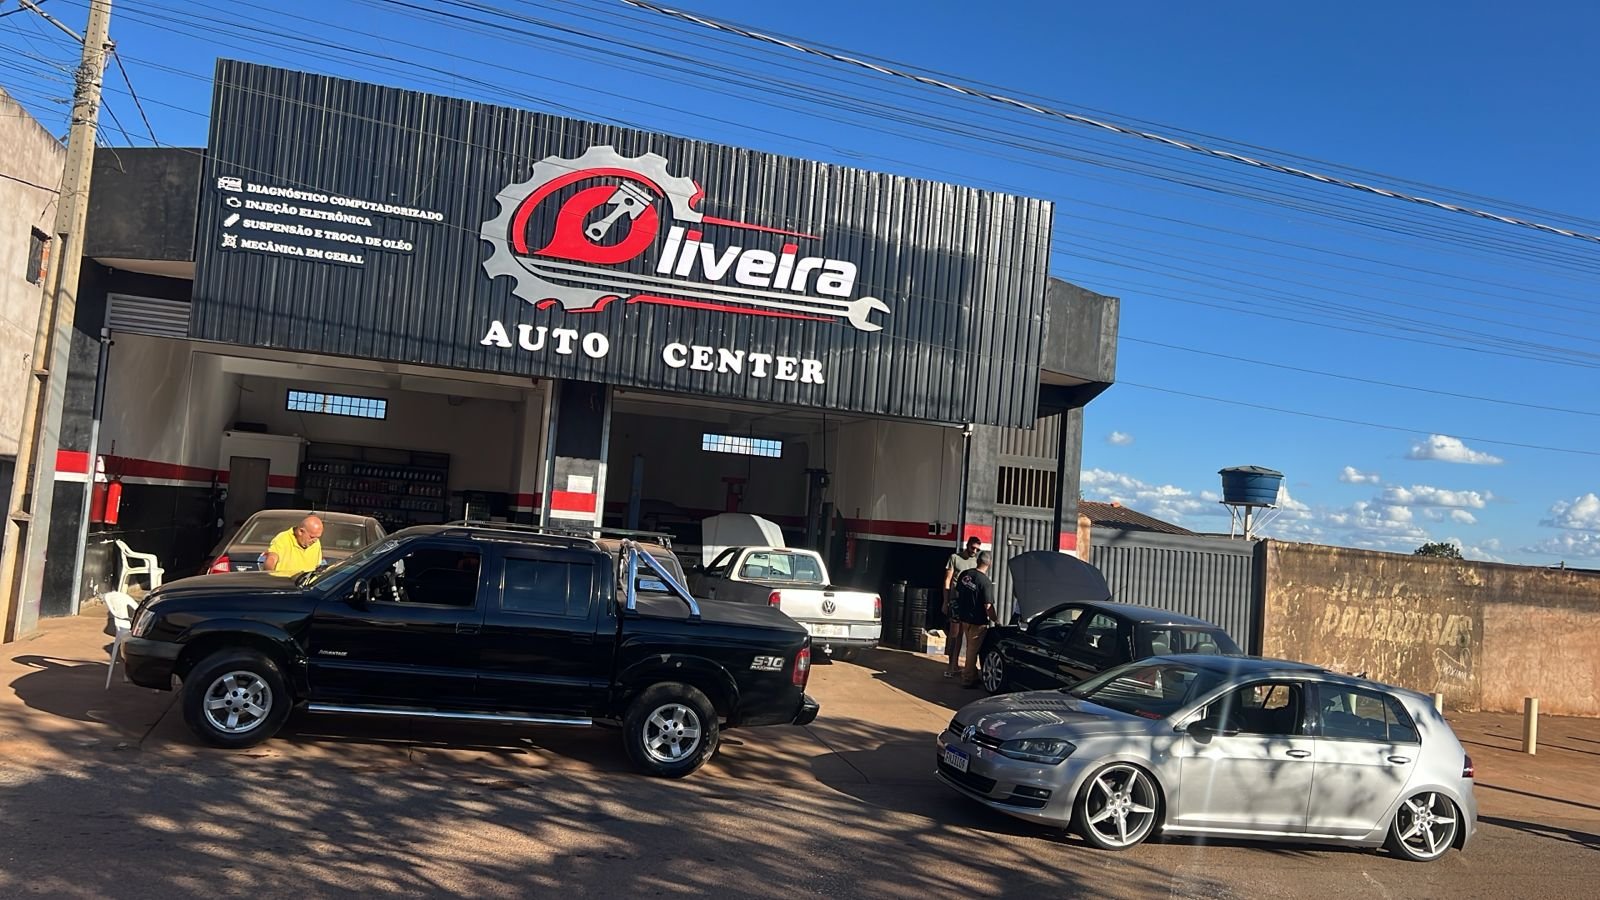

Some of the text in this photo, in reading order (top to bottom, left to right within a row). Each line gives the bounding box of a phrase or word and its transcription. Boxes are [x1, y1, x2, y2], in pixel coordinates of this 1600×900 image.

[245, 200, 372, 227] INJEÇÃO ELETRÔNICA
[247, 183, 444, 222] DIAGNÓSTICO COMPUTADORIZADO
[240, 239, 364, 264] MECÂNICA EM GERAL
[242, 219, 413, 252] SUSPENSÃO E TROCA DE OLÉO
[533, 184, 858, 297] Oliveira
[480, 320, 825, 384] AUTO CENTER
